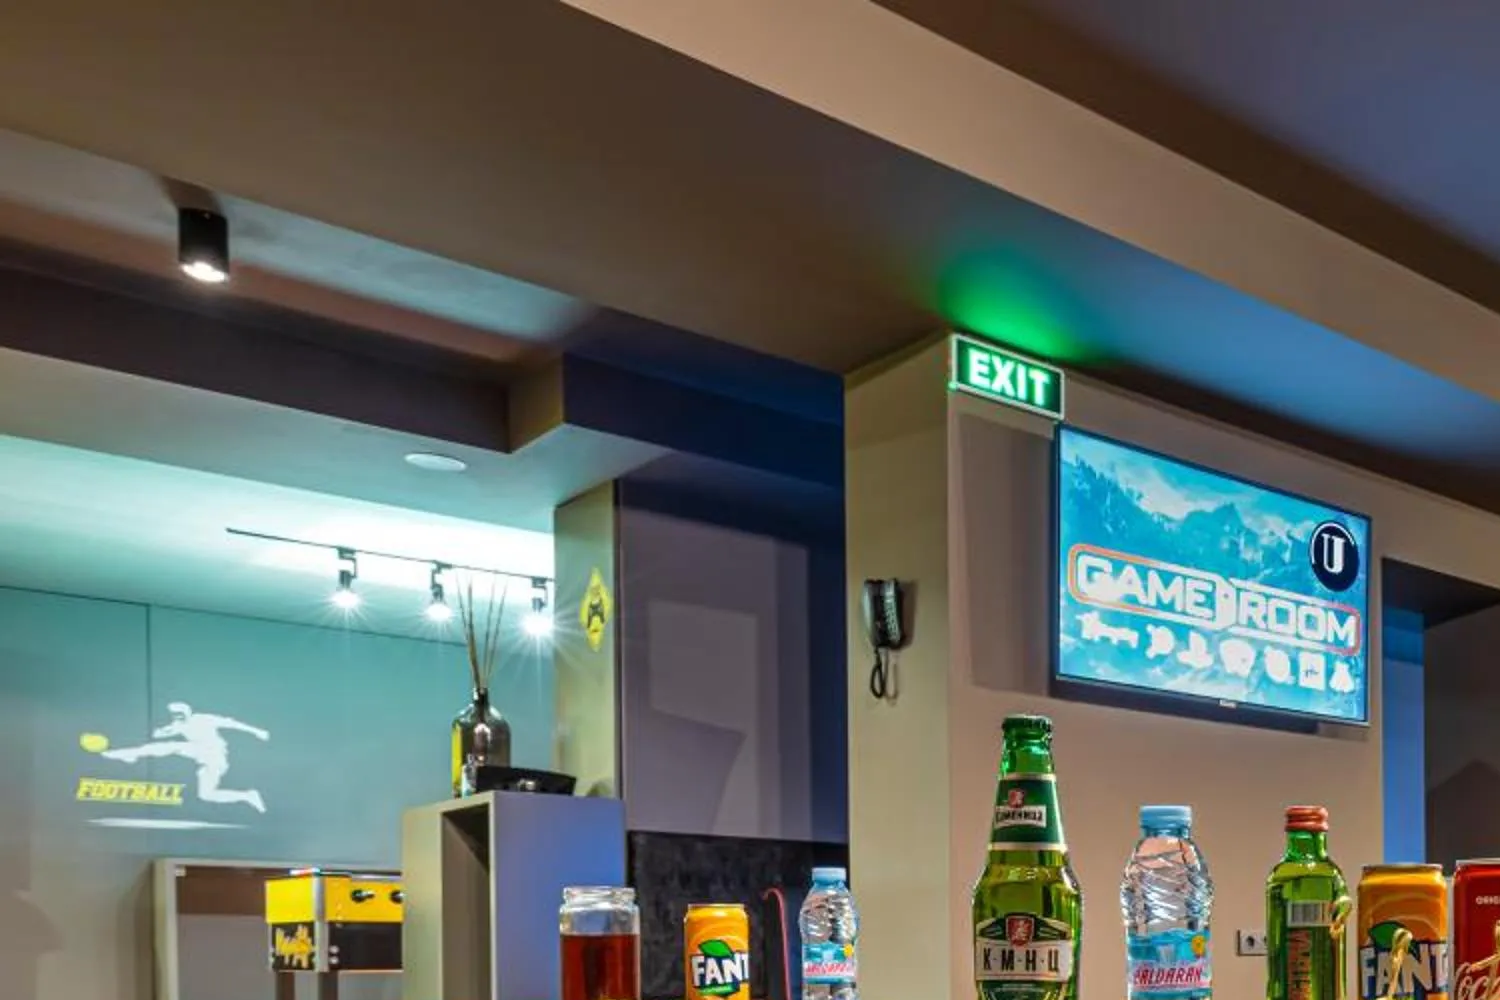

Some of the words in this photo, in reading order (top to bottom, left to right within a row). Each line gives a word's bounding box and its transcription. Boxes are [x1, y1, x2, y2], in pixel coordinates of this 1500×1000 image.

[967, 347, 1050, 407] EXIT
[1076, 552, 1218, 623] GAME
[1237, 587, 1358, 648] ROOM
[77, 777, 186, 805] FOOTBALL
[692, 952, 749, 987] FANT
[1360, 942, 1449, 998] FANT
